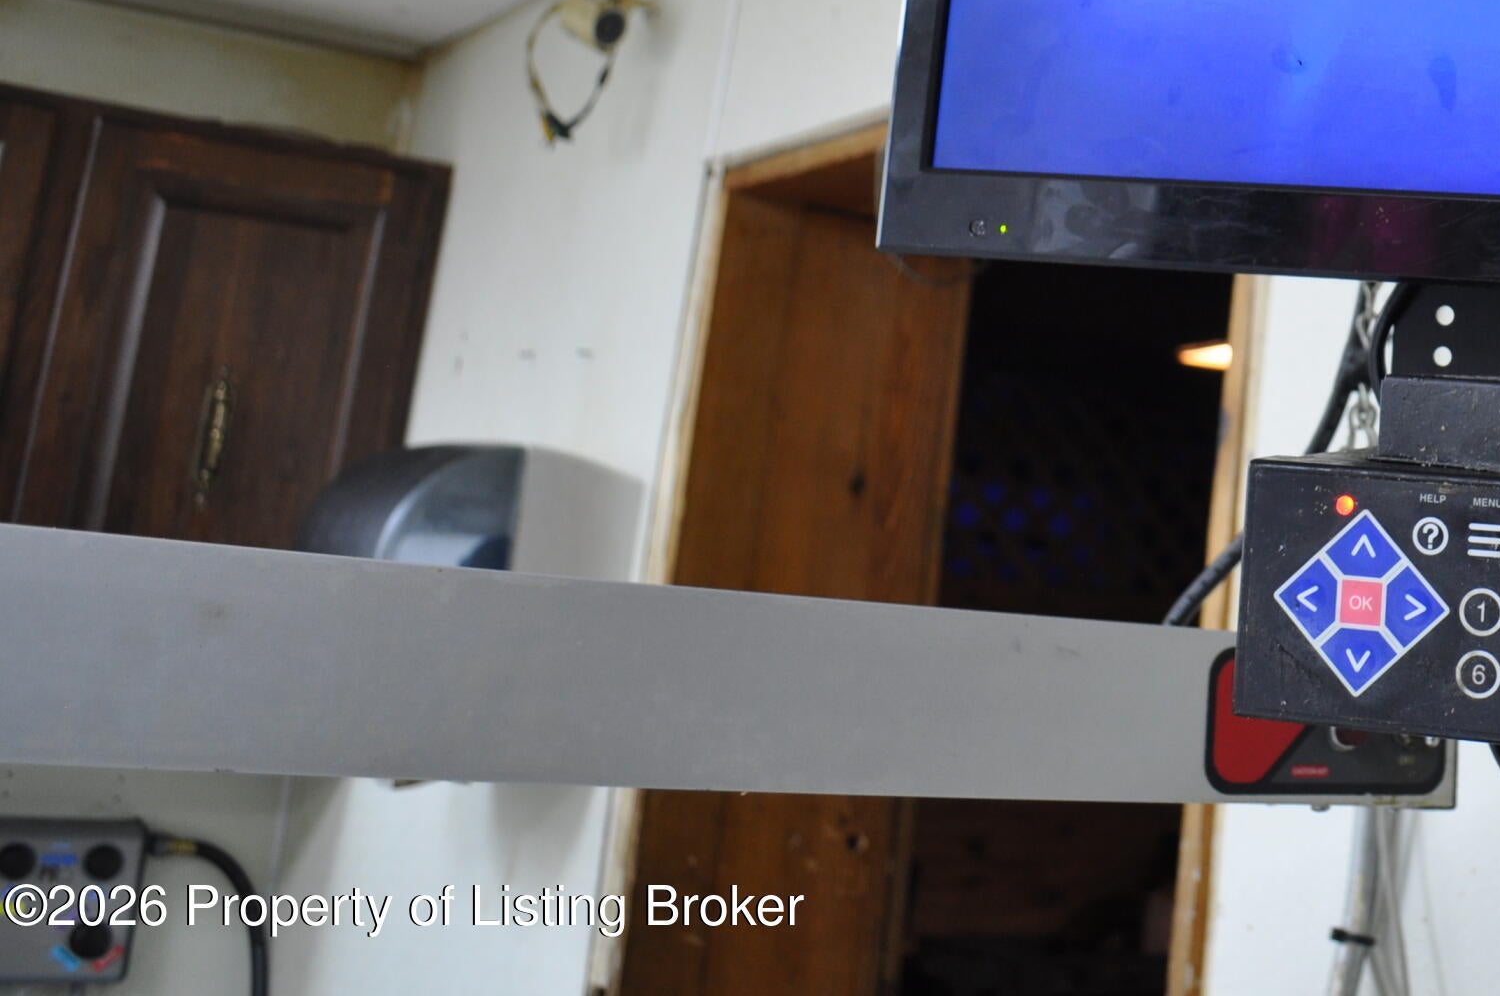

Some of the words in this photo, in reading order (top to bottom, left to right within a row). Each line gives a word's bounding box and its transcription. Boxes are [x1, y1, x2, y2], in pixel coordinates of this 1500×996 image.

[1419, 493, 1447, 504] HELP
[1348, 594, 1373, 611] OK
[1476, 601, 1486, 623] 1
[1471, 664, 1486, 685] 6
